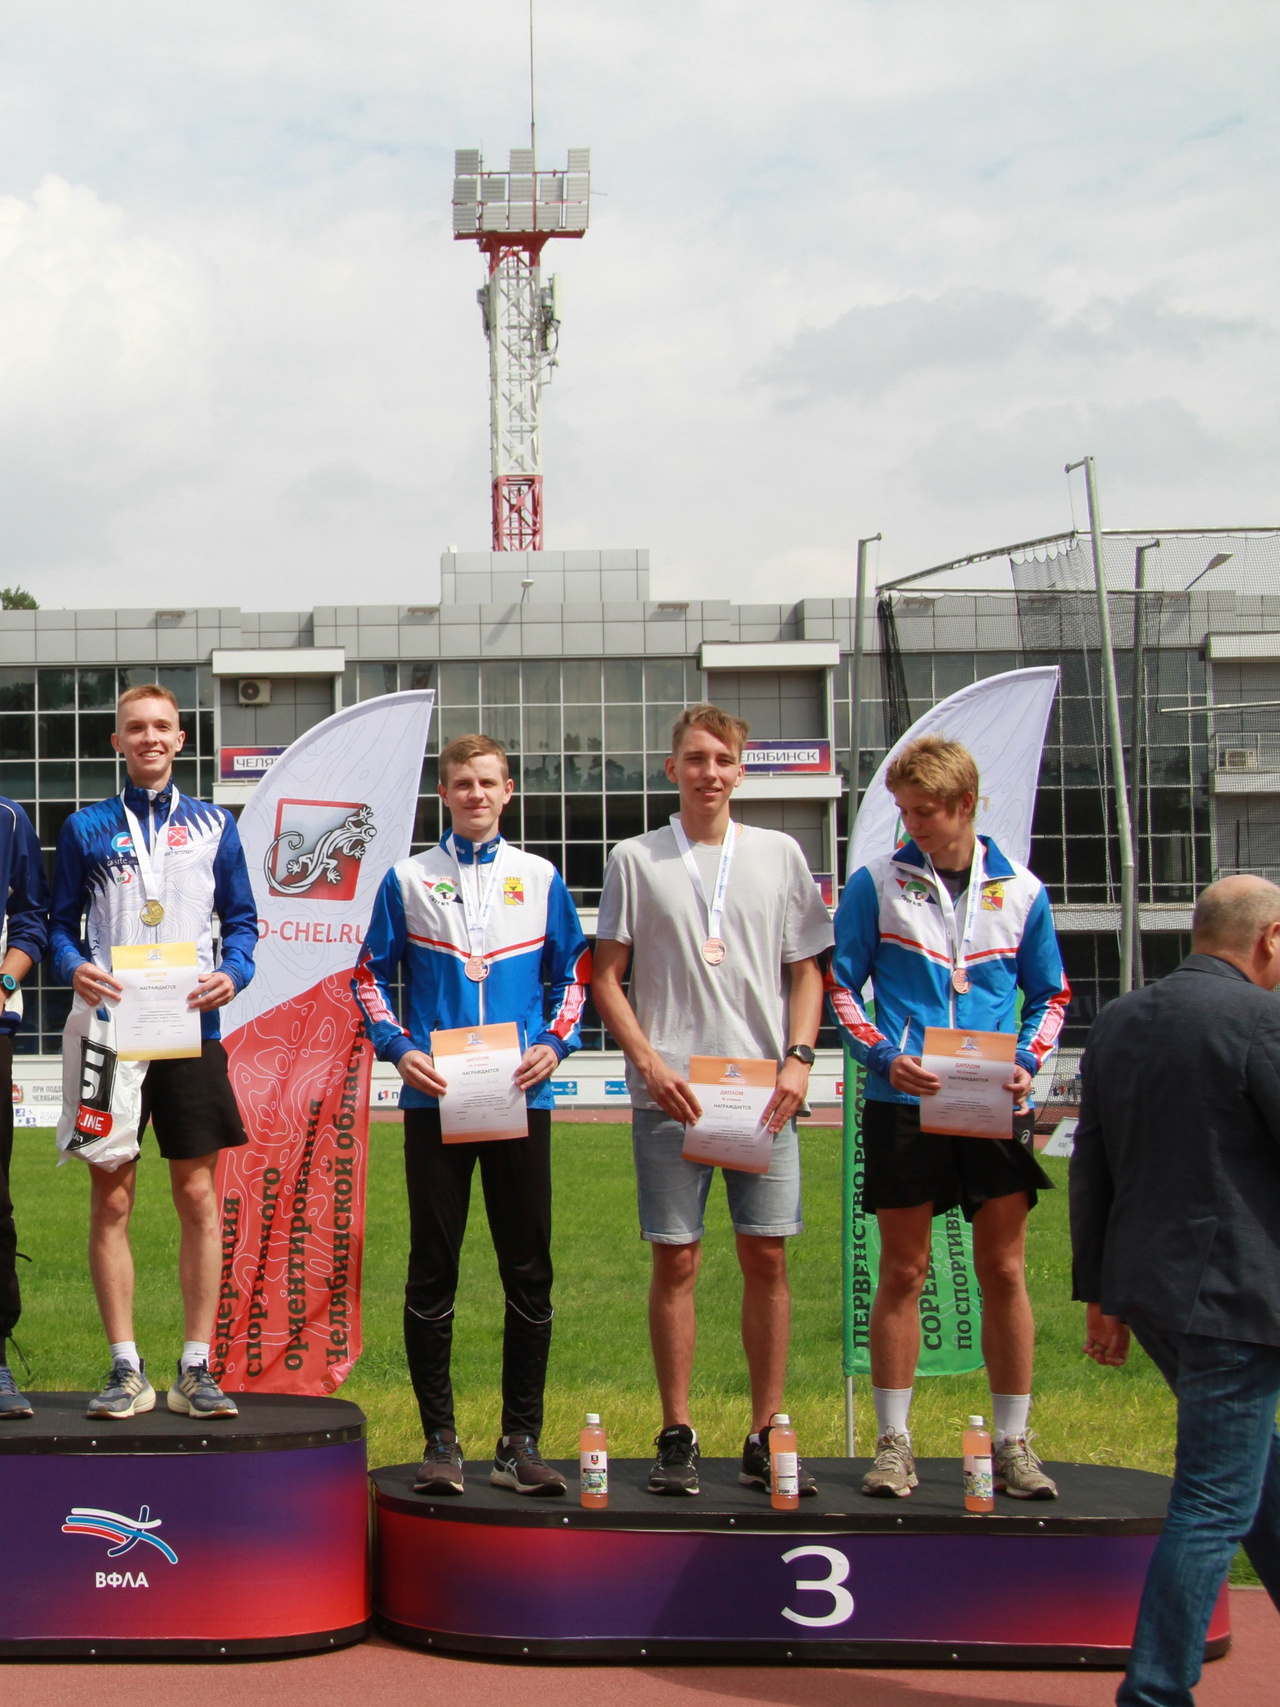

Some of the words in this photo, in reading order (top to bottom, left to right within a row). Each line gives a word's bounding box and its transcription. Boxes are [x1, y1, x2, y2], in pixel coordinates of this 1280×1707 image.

[852, 1169, 871, 1350] ПЕРВЕНСТВО
[956, 1319, 972, 1351] ПО
[94, 1571, 150, 1589] ВФЛА
[780, 1545, 855, 1628] 3
